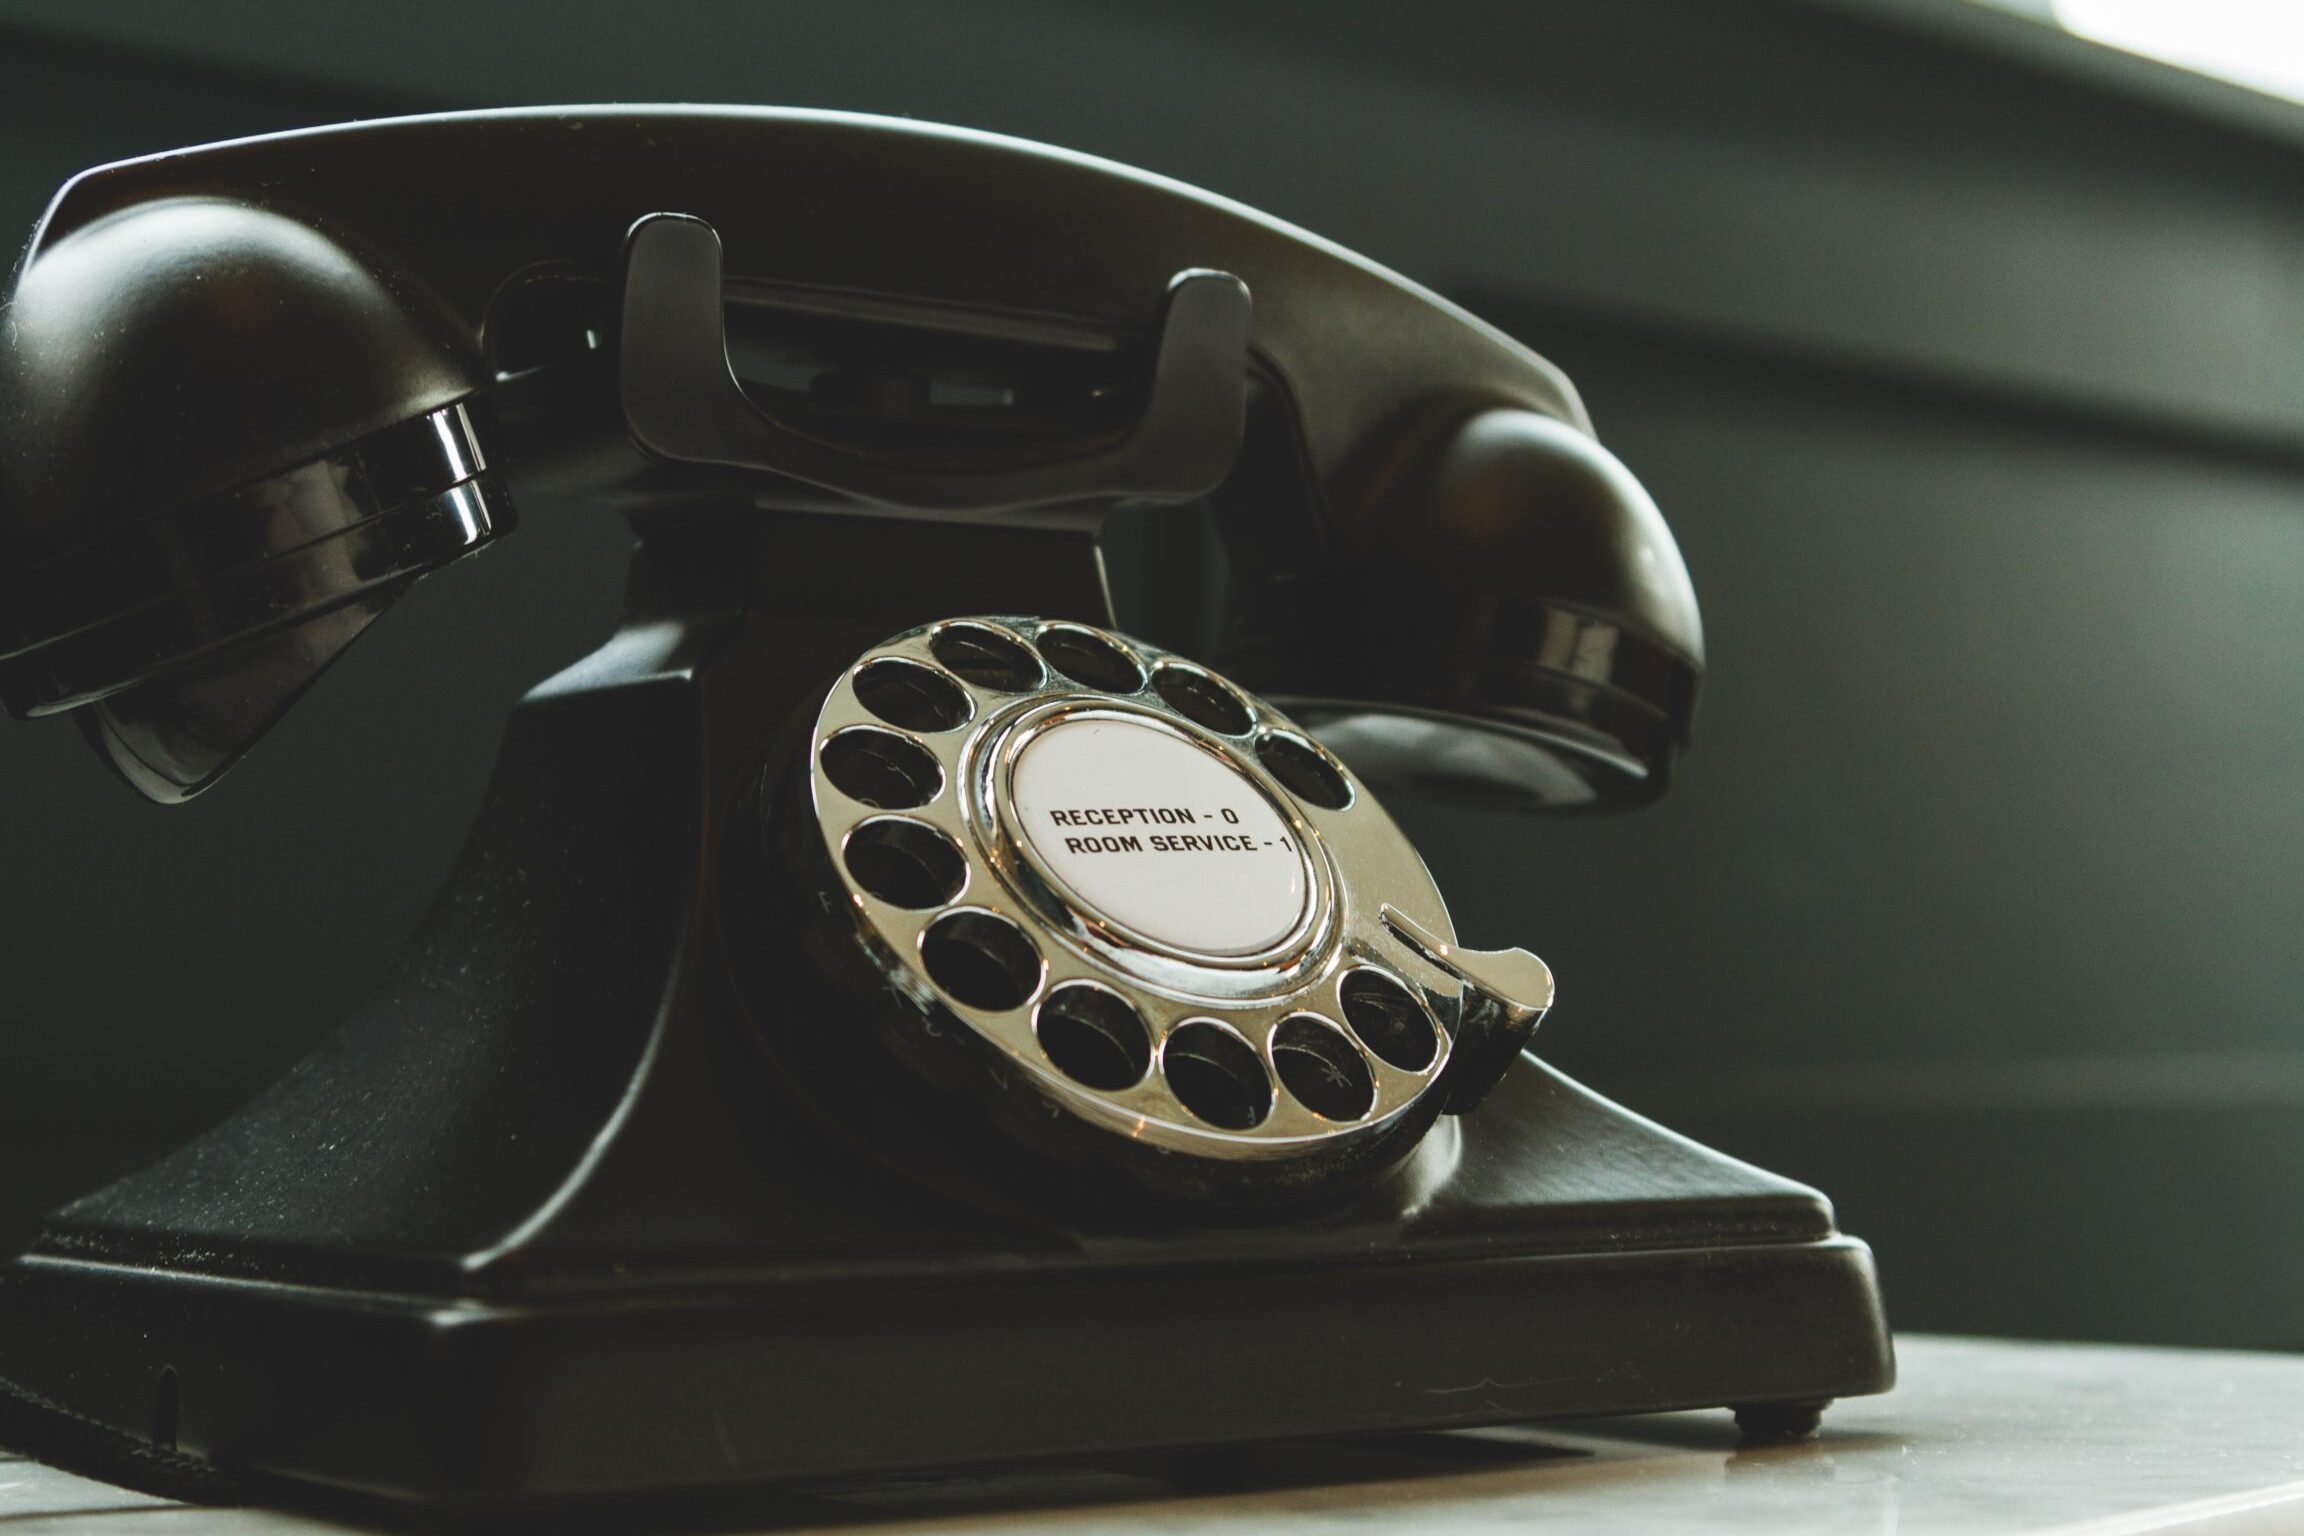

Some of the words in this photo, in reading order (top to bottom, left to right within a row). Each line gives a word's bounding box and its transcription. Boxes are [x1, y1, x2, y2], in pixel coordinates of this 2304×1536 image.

[1049, 808, 1196, 827] RECEPTION
[1064, 835, 1144, 855] ROOM
[1149, 835, 1258, 852] SERVICE
